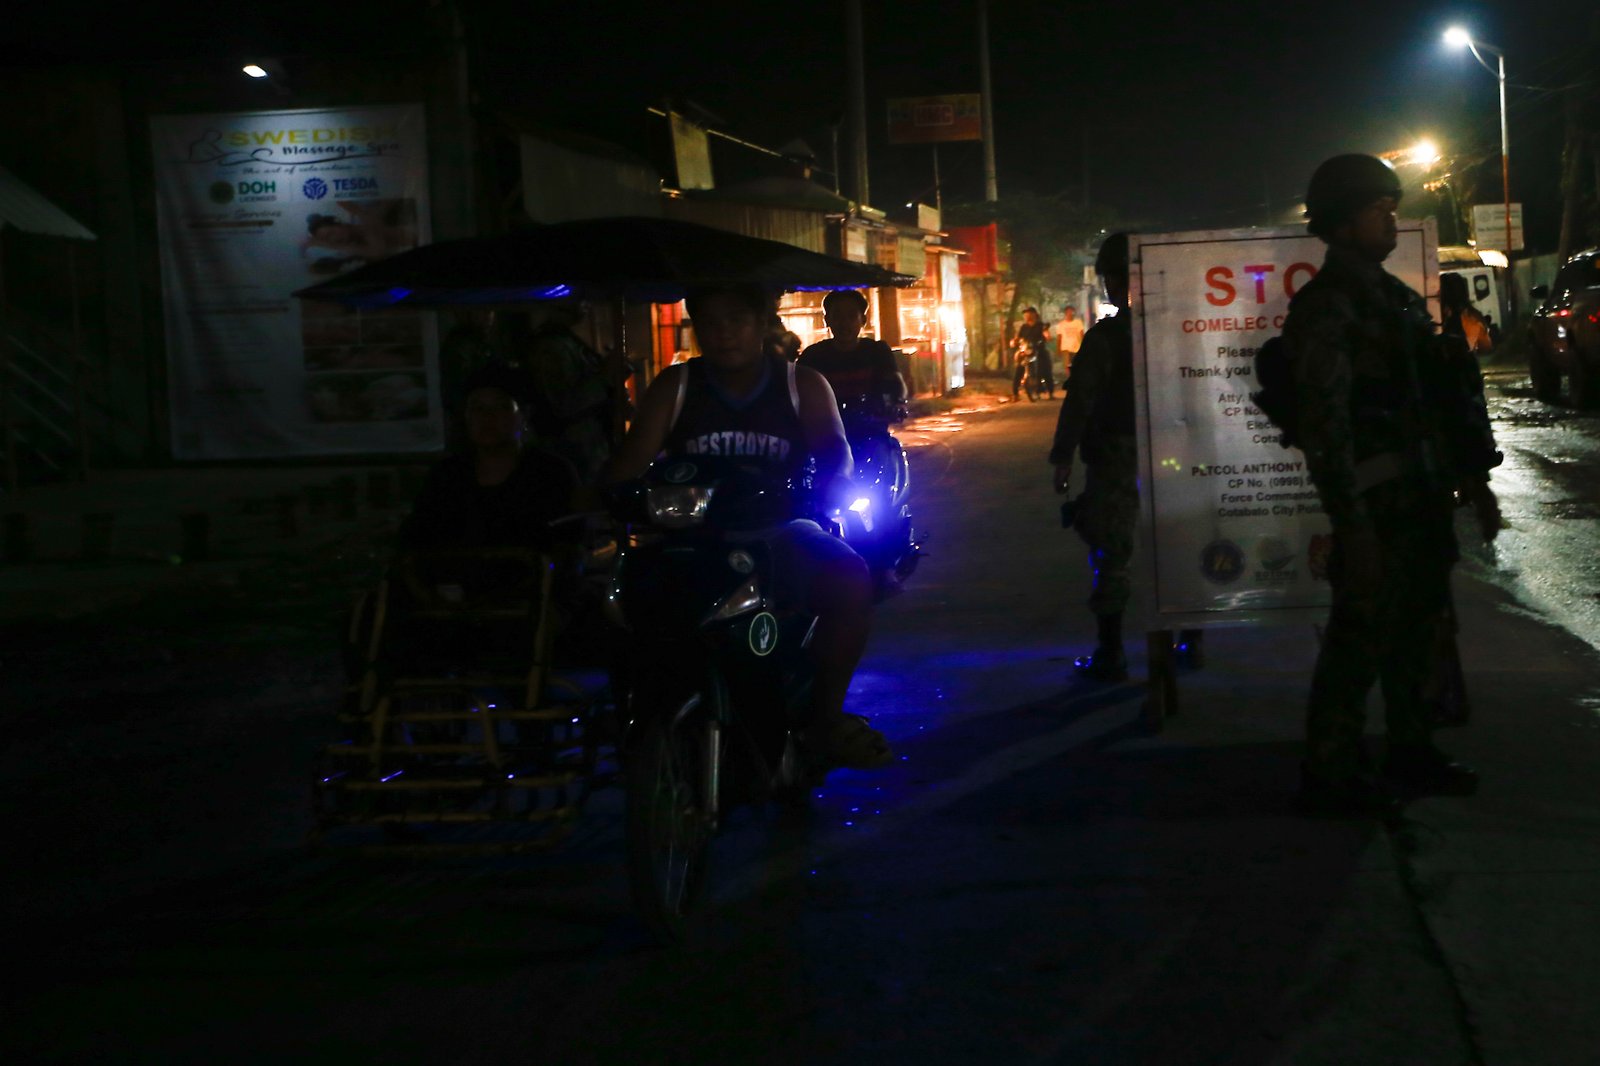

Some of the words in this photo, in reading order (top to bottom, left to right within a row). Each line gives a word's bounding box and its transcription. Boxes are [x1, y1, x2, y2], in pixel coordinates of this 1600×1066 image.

[367, 141, 400, 156] Spa
[238, 181, 276, 195] DOH
[333, 177, 379, 191] TESDA
[1205, 262, 1318, 306] STO
[1182, 316, 1267, 334] COMELEC
[1217, 345, 1262, 358] Pleas
[1179, 366, 1221, 378] Thank
[1225, 365, 1251, 378] you
[1218, 392, 1245, 404] Atty.
[1224, 406, 1240, 416] CP
[1242, 461, 1303, 474] ANTHONY
[1227, 478, 1244, 489] CP
[1247, 478, 1267, 488] No.
[1221, 492, 1253, 504] Force
[1271, 503, 1294, 517] City
